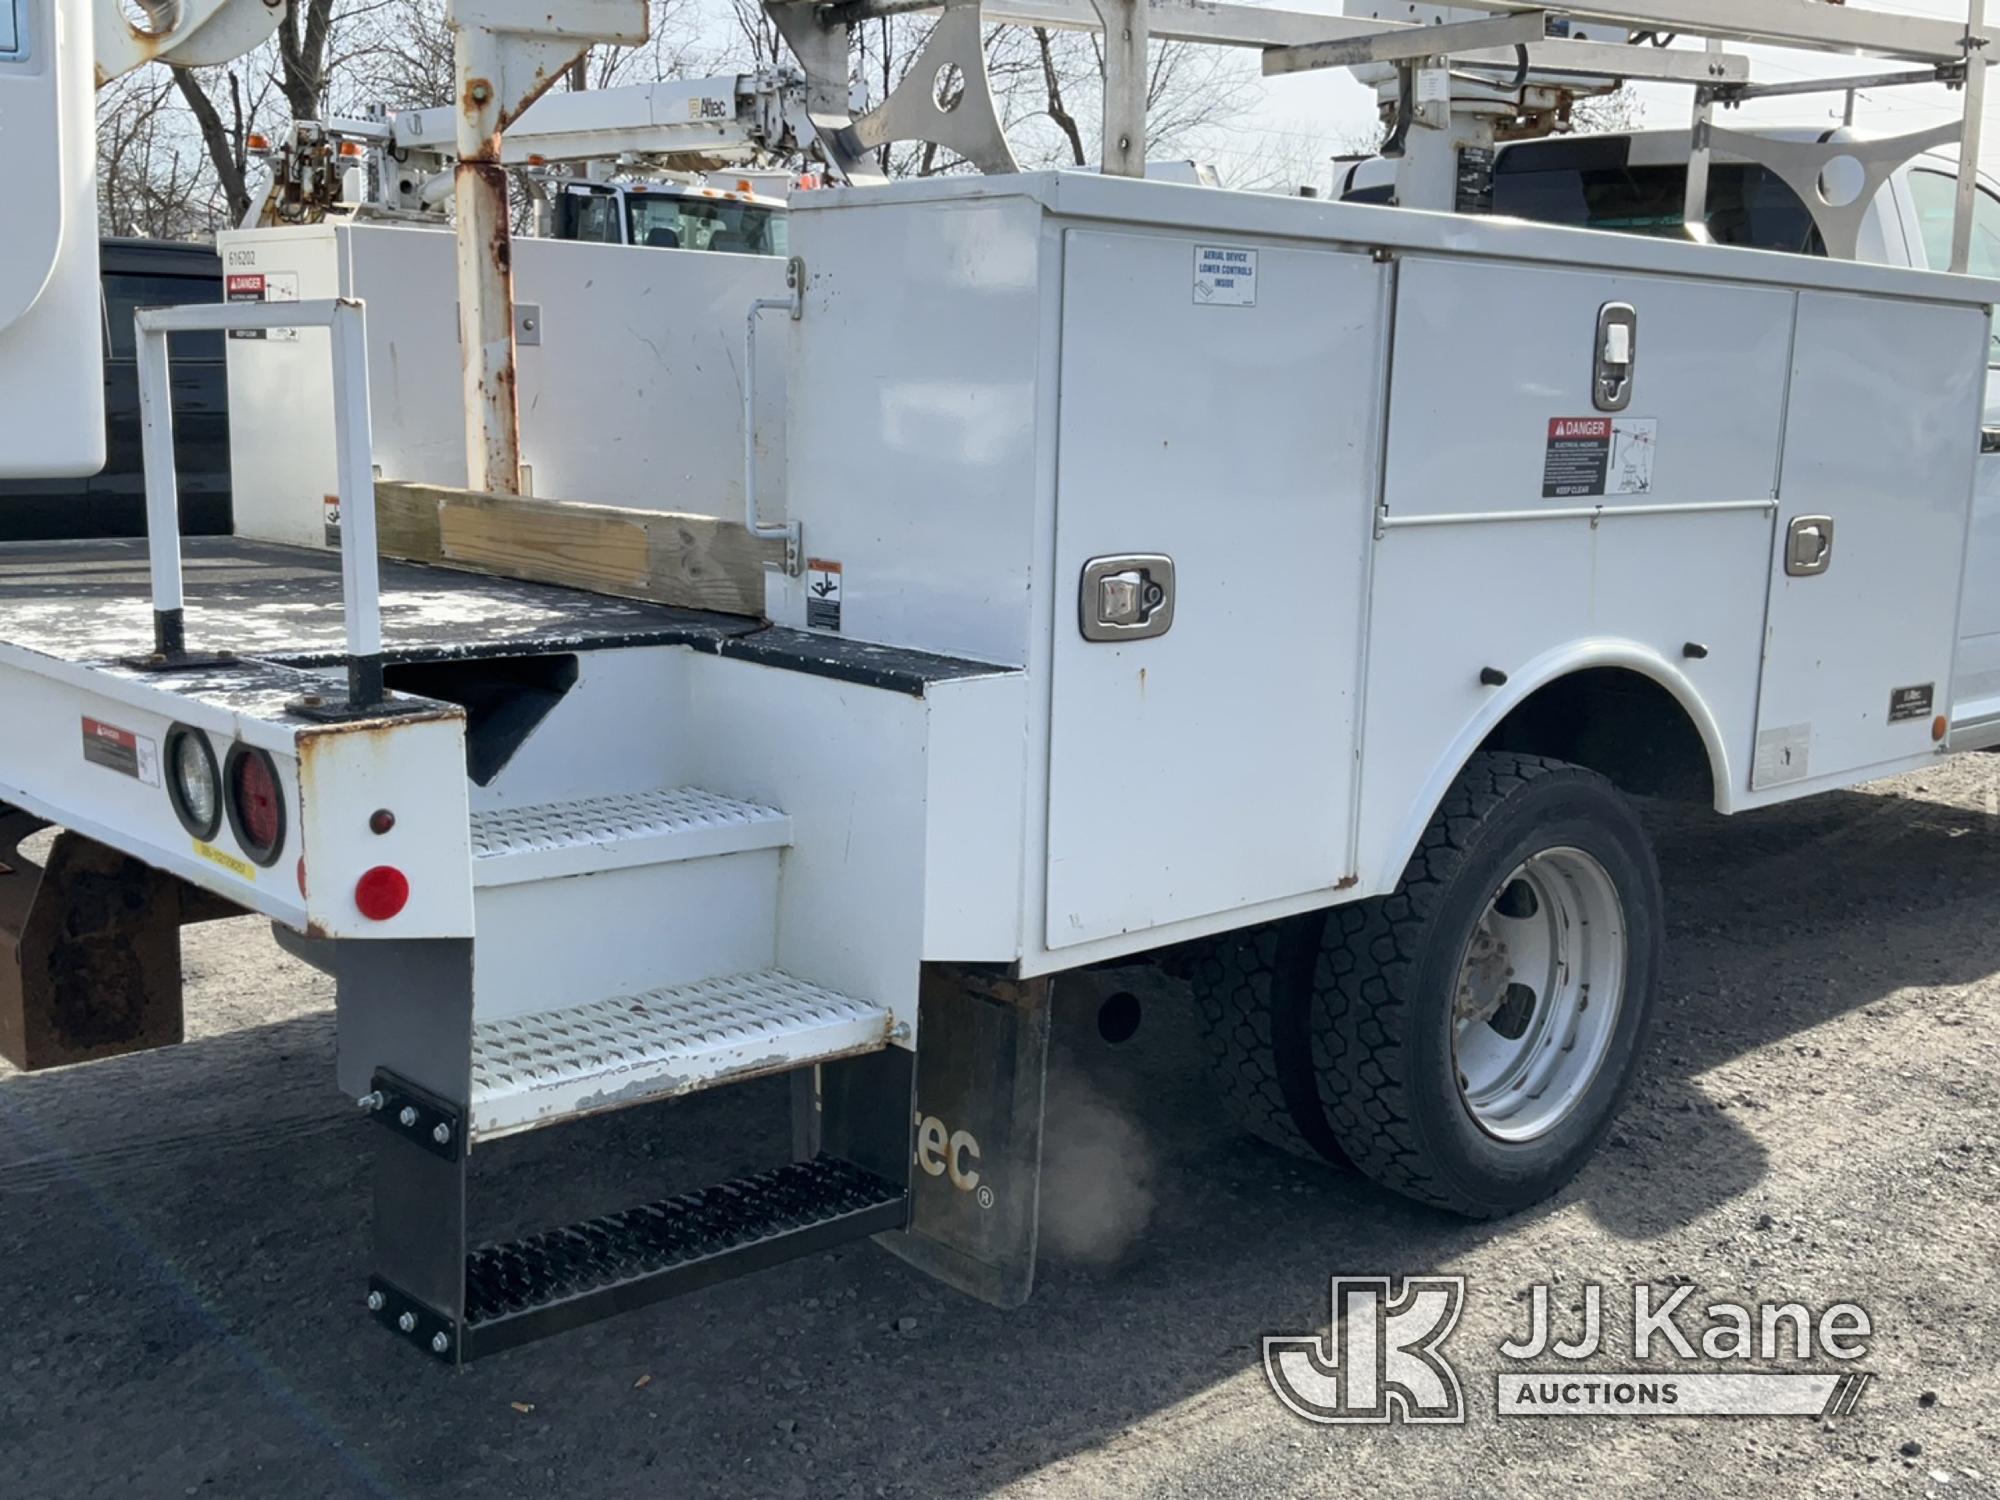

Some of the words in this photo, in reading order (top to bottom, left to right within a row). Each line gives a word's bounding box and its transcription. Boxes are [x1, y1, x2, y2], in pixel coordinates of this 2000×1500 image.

[701, 97, 726, 117] Altec
[1226, 252, 1247, 263] DEVICE
[1199, 263, 1220, 273] LOWER
[1222, 265, 1252, 276] CONTROLS
[1215, 279, 1234, 288] INSIDE
[1566, 421, 1605, 436] DANGER
